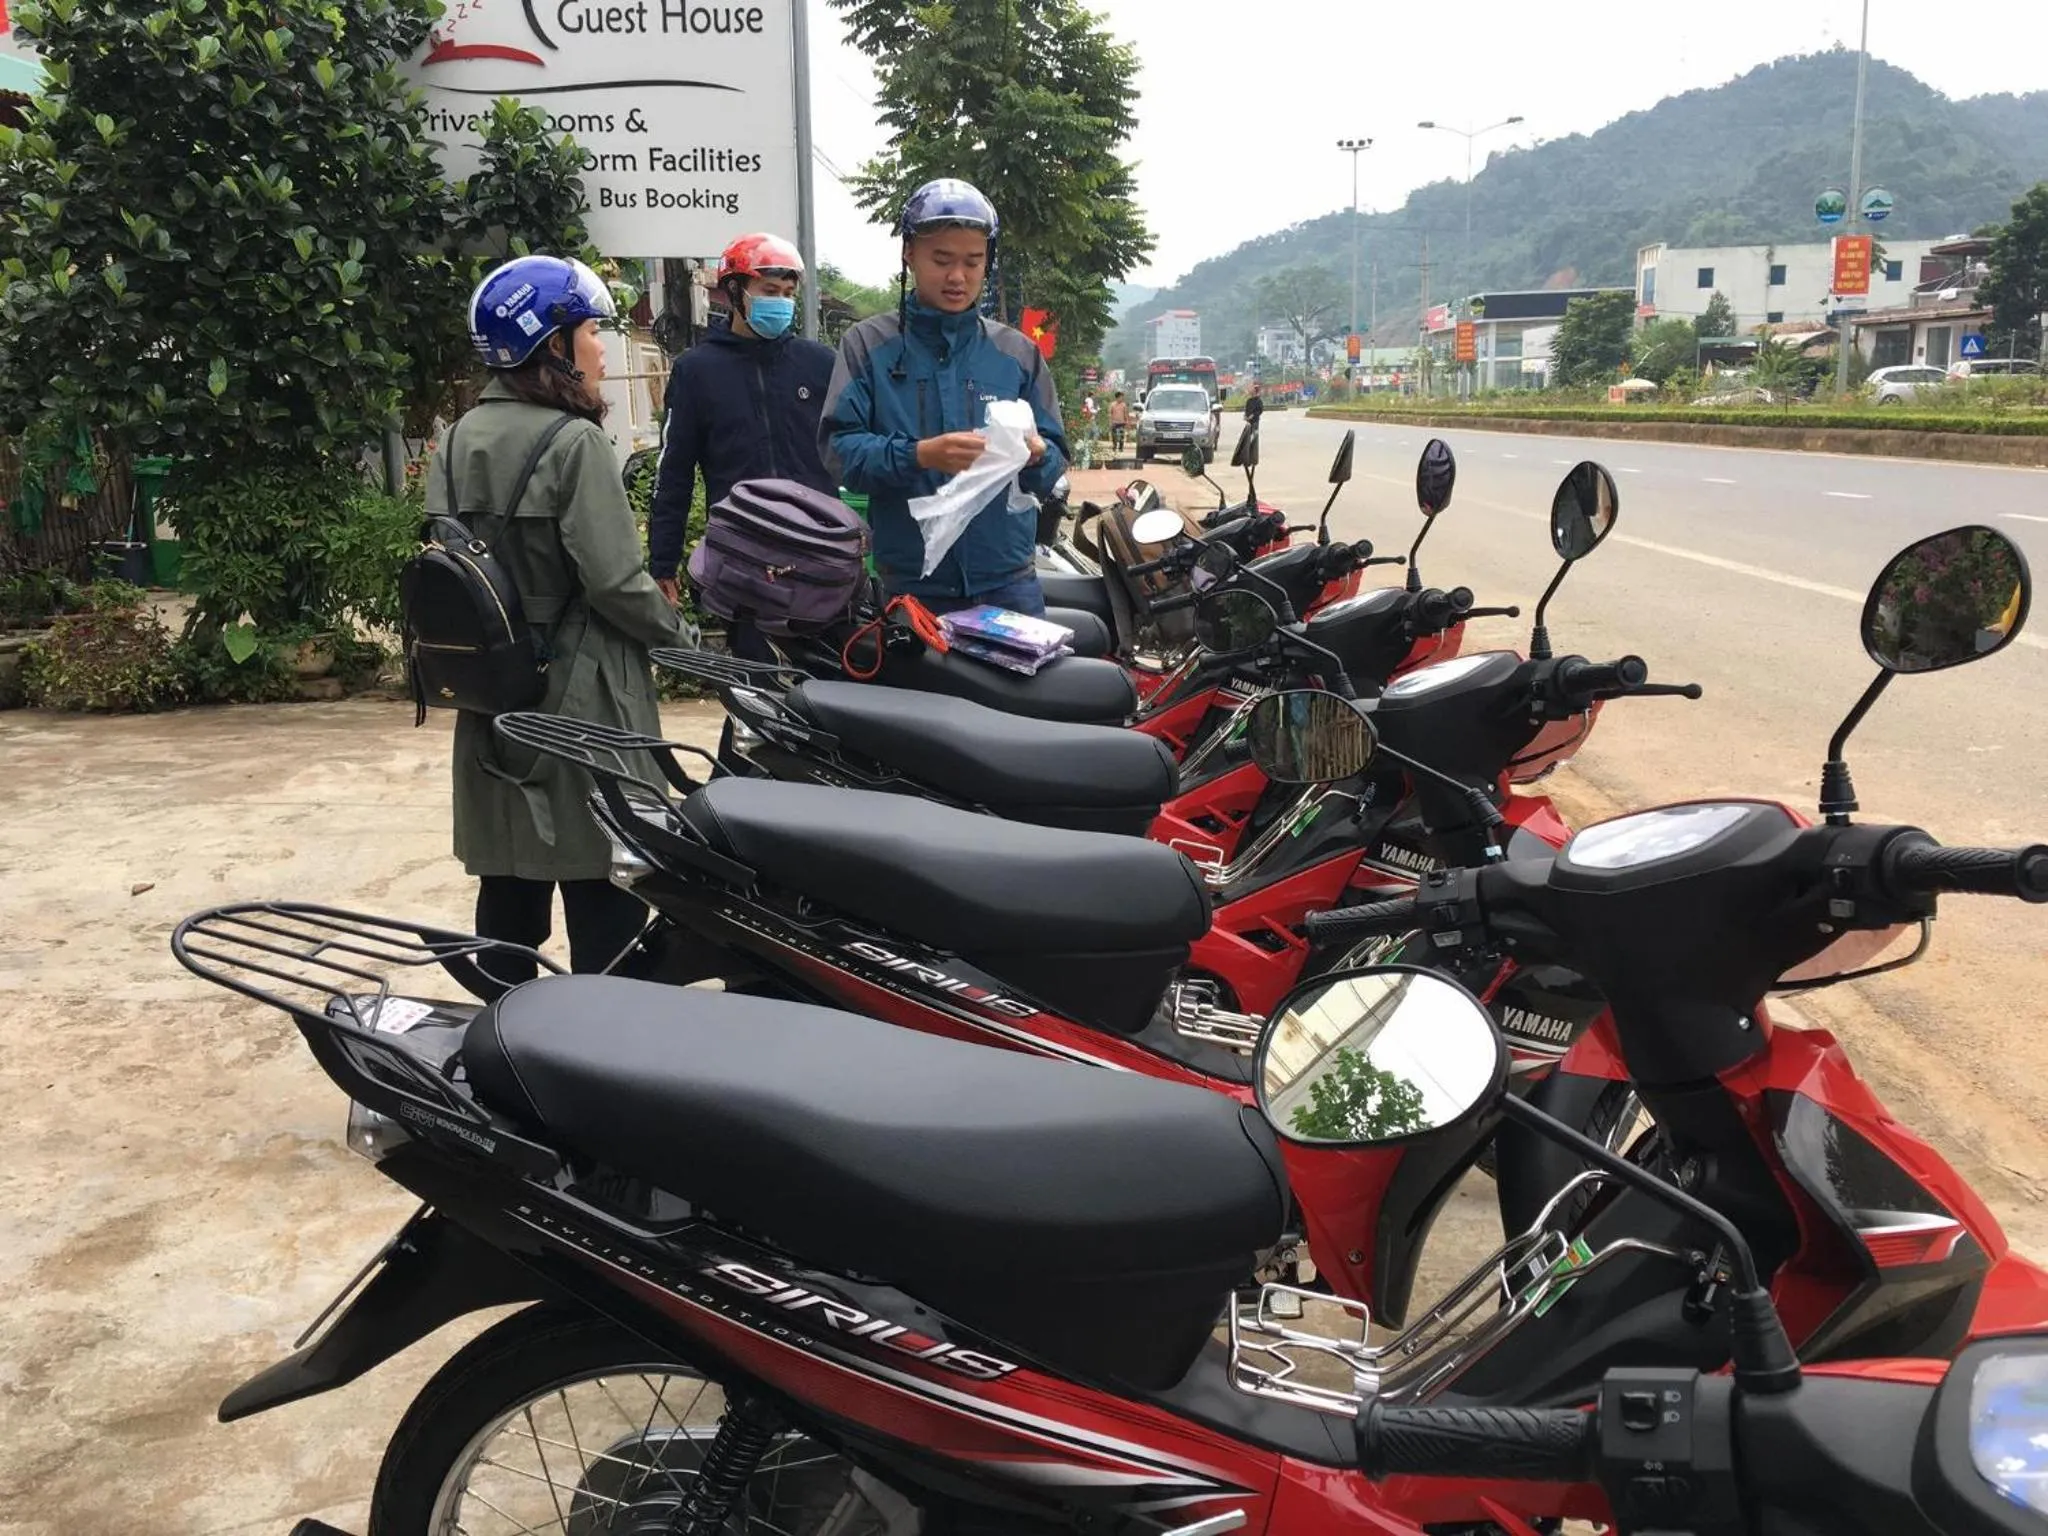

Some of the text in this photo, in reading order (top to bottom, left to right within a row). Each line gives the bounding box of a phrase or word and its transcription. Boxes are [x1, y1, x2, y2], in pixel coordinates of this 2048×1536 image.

[557, 0, 763, 34] Guest House
[415, 108, 493, 132] Privat
[625, 108, 649, 133] &
[582, 147, 762, 172] orm Facilities
[600, 188, 637, 208] Bus
[646, 188, 739, 214] Booking
[1381, 842, 1437, 873] YAMAHA
[840, 942, 1040, 1017] SIRIUS
[1502, 1005, 1574, 1041] YAMAHA
[518, 1206, 813, 1345] STYLISH EDITION
[700, 1263, 1019, 1379] SIRIUS
